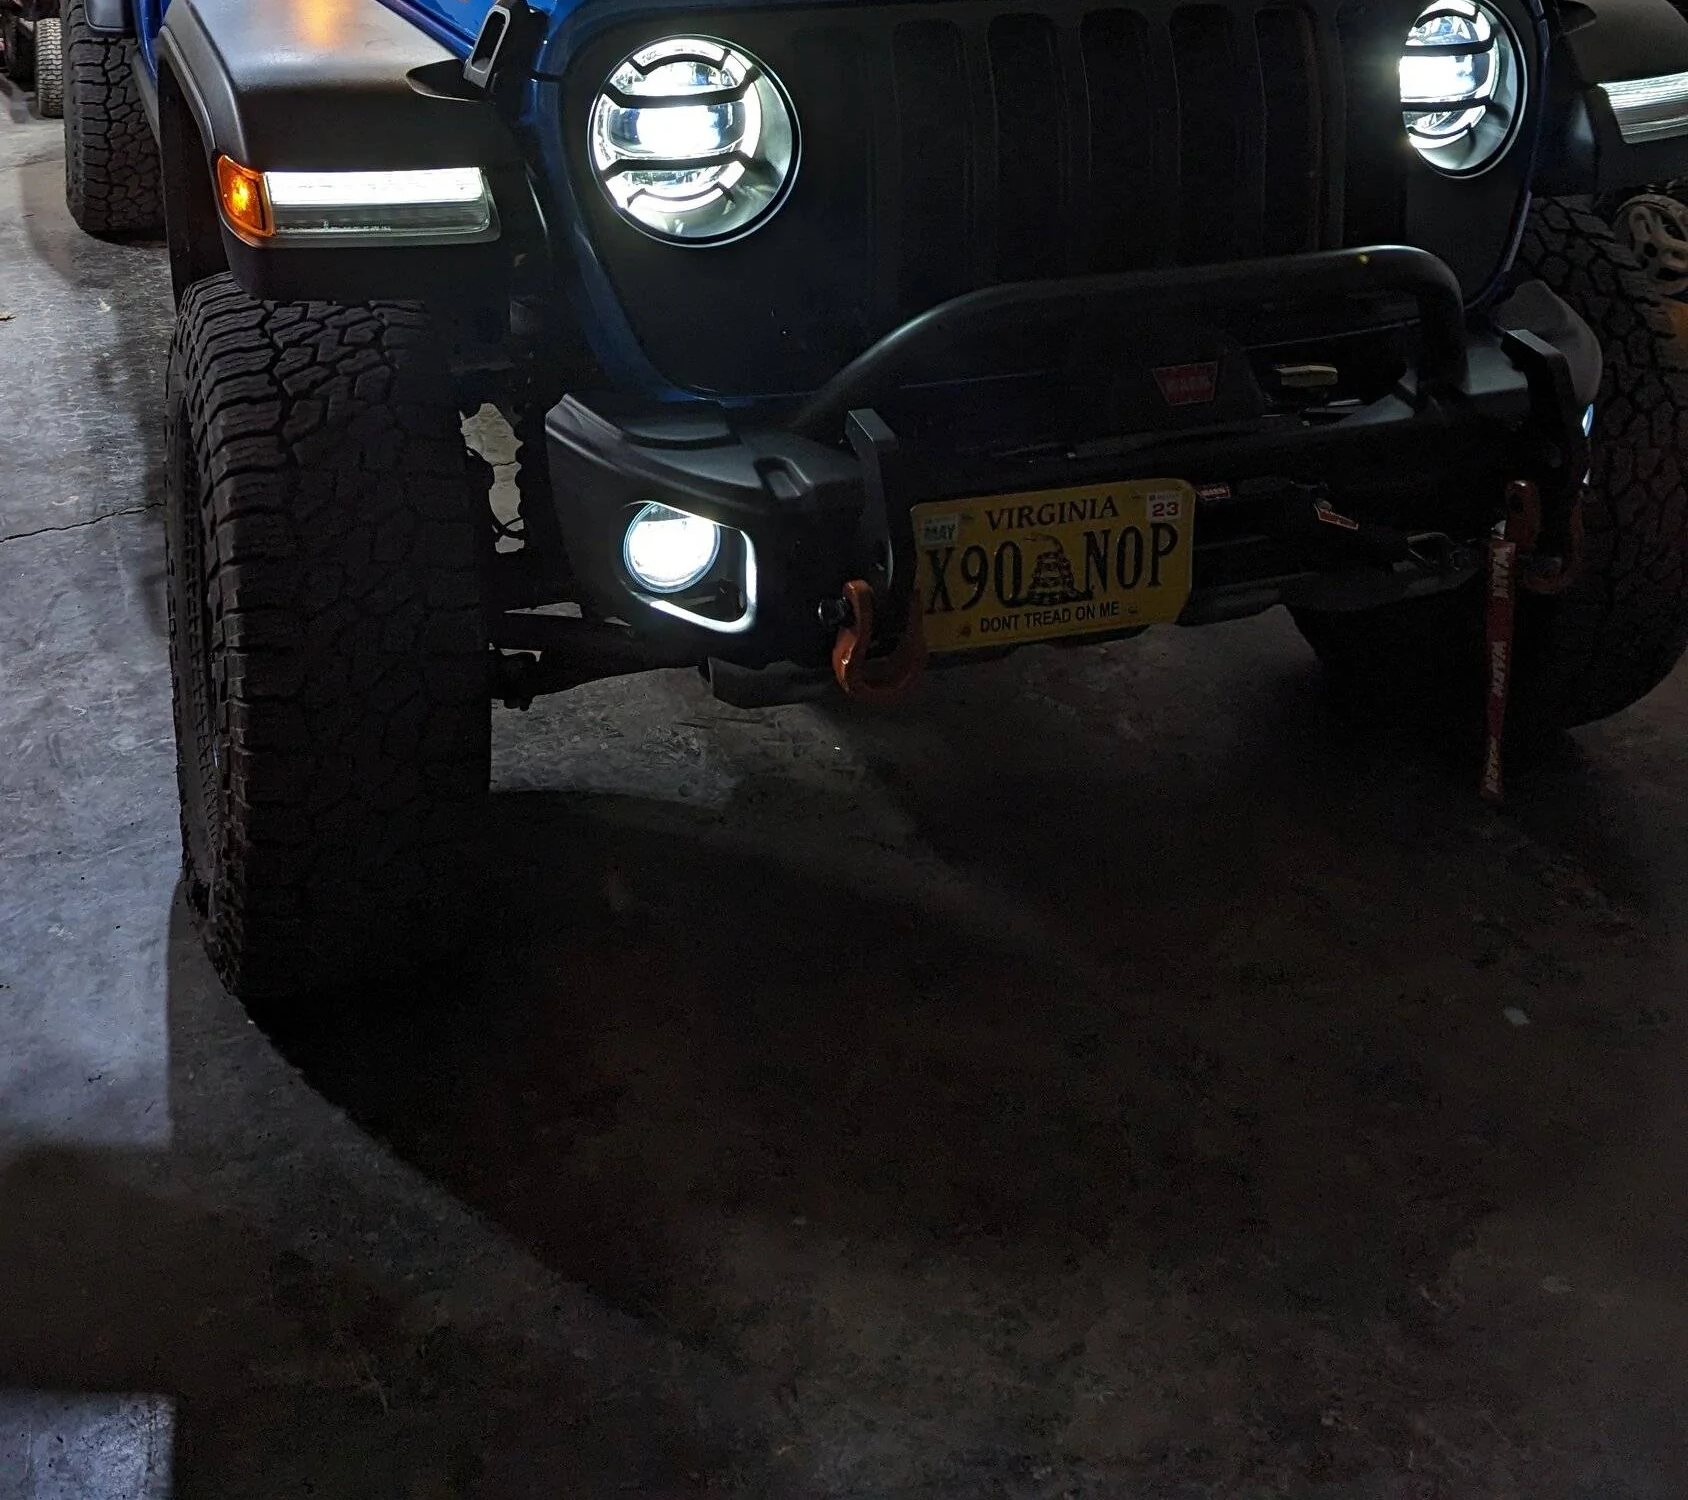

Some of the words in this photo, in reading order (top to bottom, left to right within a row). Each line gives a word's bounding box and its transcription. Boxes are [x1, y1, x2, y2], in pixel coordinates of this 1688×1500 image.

[985, 495, 1119, 531] VIRGINIA
[1152, 501, 1179, 517] 23
[980, 612, 1020, 632] DONT
[1024, 607, 1071, 627] TREAD
[1075, 604, 1095, 619] ON
[1098, 601, 1120, 616] ME
